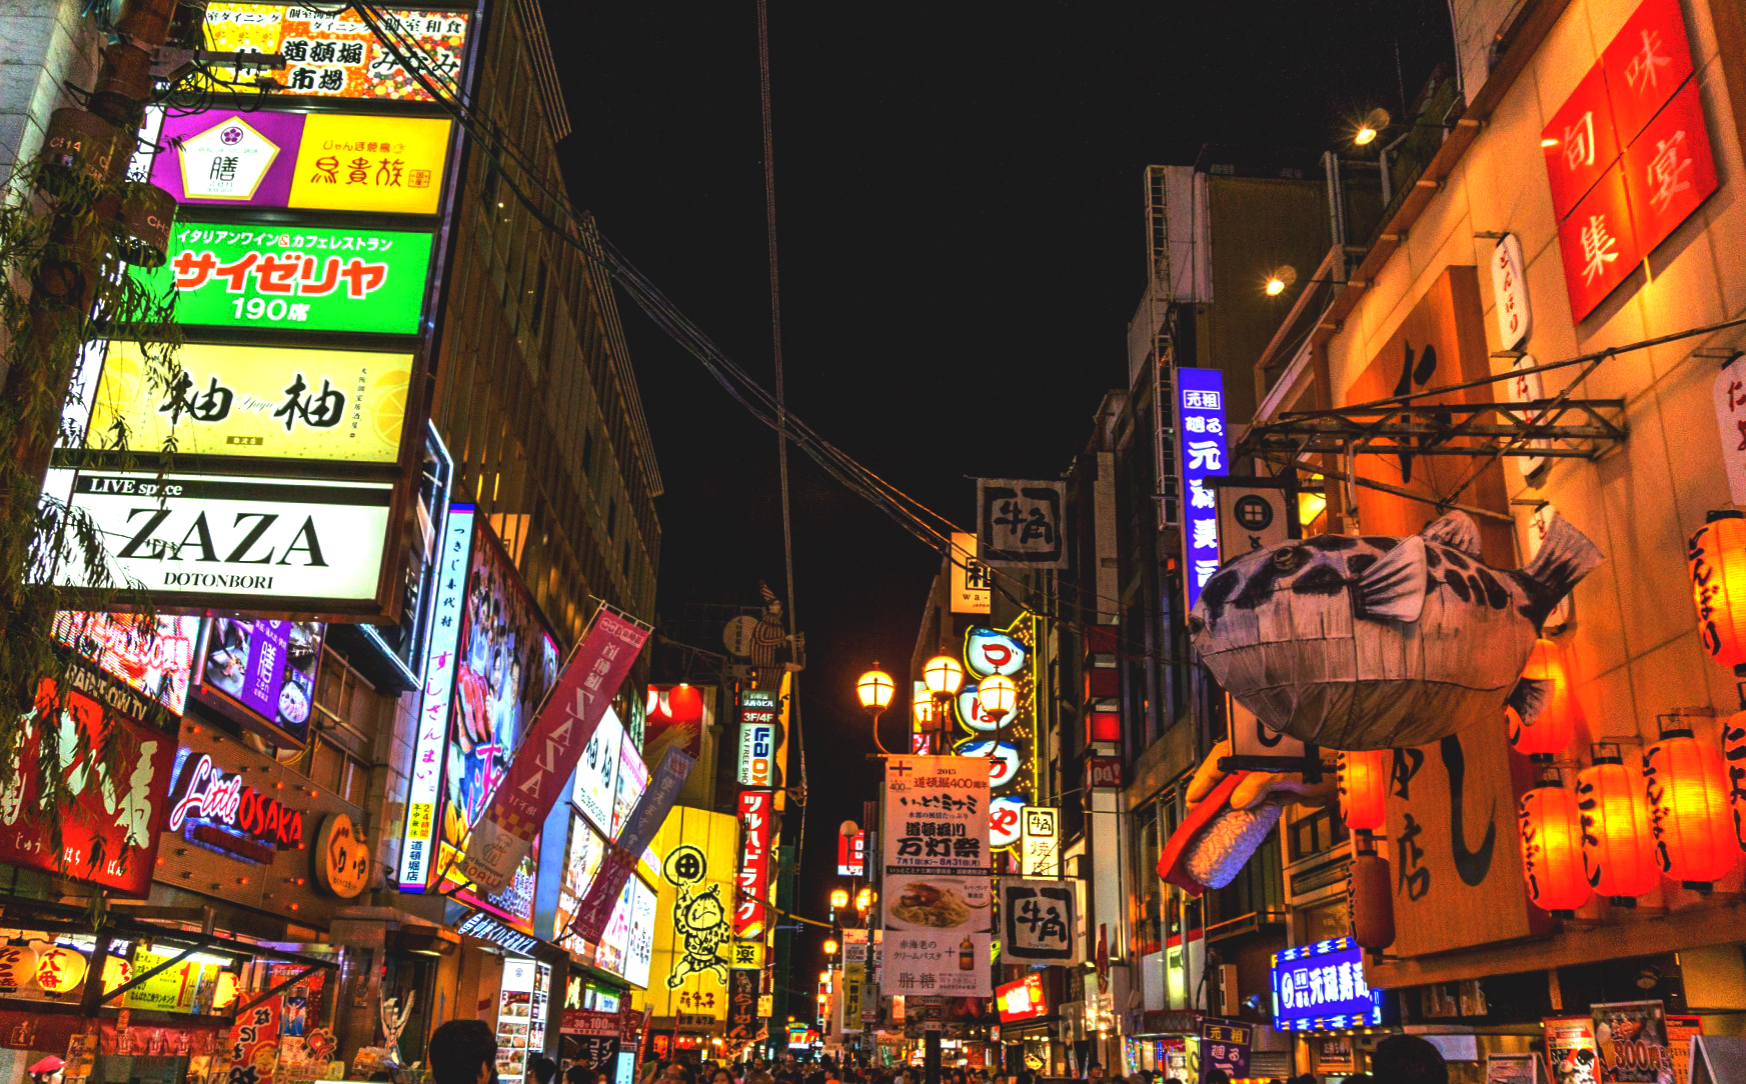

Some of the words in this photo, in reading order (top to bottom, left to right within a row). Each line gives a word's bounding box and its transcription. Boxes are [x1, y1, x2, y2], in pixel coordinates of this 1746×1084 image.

[384, 17, 464, 34] 個室和食
[284, 40, 365, 65] 道頓堀
[372, 50, 460, 74] みなみ
[291, 68, 344, 91] 市場
[209, 156, 240, 181] 膳
[310, 156, 405, 188] 鳥貴族
[172, 251, 388, 298] サイゼリヤ
[232, 297, 311, 322] 190席
[159, 370, 233, 425] 柚
[273, 373, 346, 431] 柚
[1186, 393, 1219, 408] 元祖
[89, 478, 136, 494] LIVE
[993, 501, 1055, 545] 牛角
[116, 508, 330, 567] ZAZA
[164, 572, 273, 590] DOTONBORI
[416, 651, 453, 779] すしざんまい
[743, 712, 774, 722] 3F/4F
[742, 744, 750, 766] FREE
[741, 767, 749, 786] SHO
[914, 776, 989, 789] 道頓堀400周年
[170, 753, 242, 832] Little
[239, 787, 302, 844] OSAKA
[900, 793, 978, 815] いっとこミナミ
[419, 804, 431, 837] 24時間
[906, 821, 966, 838] 道頓堀川
[1031, 815, 1052, 832] 牛角
[896, 837, 981, 859] 万灯祭
[406, 840, 423, 882] 道頓堀店
[1016, 899, 1068, 944] 牛角
[893, 951, 943, 961] クリームパスタ
[1210, 1026, 1243, 1042] 元祖
